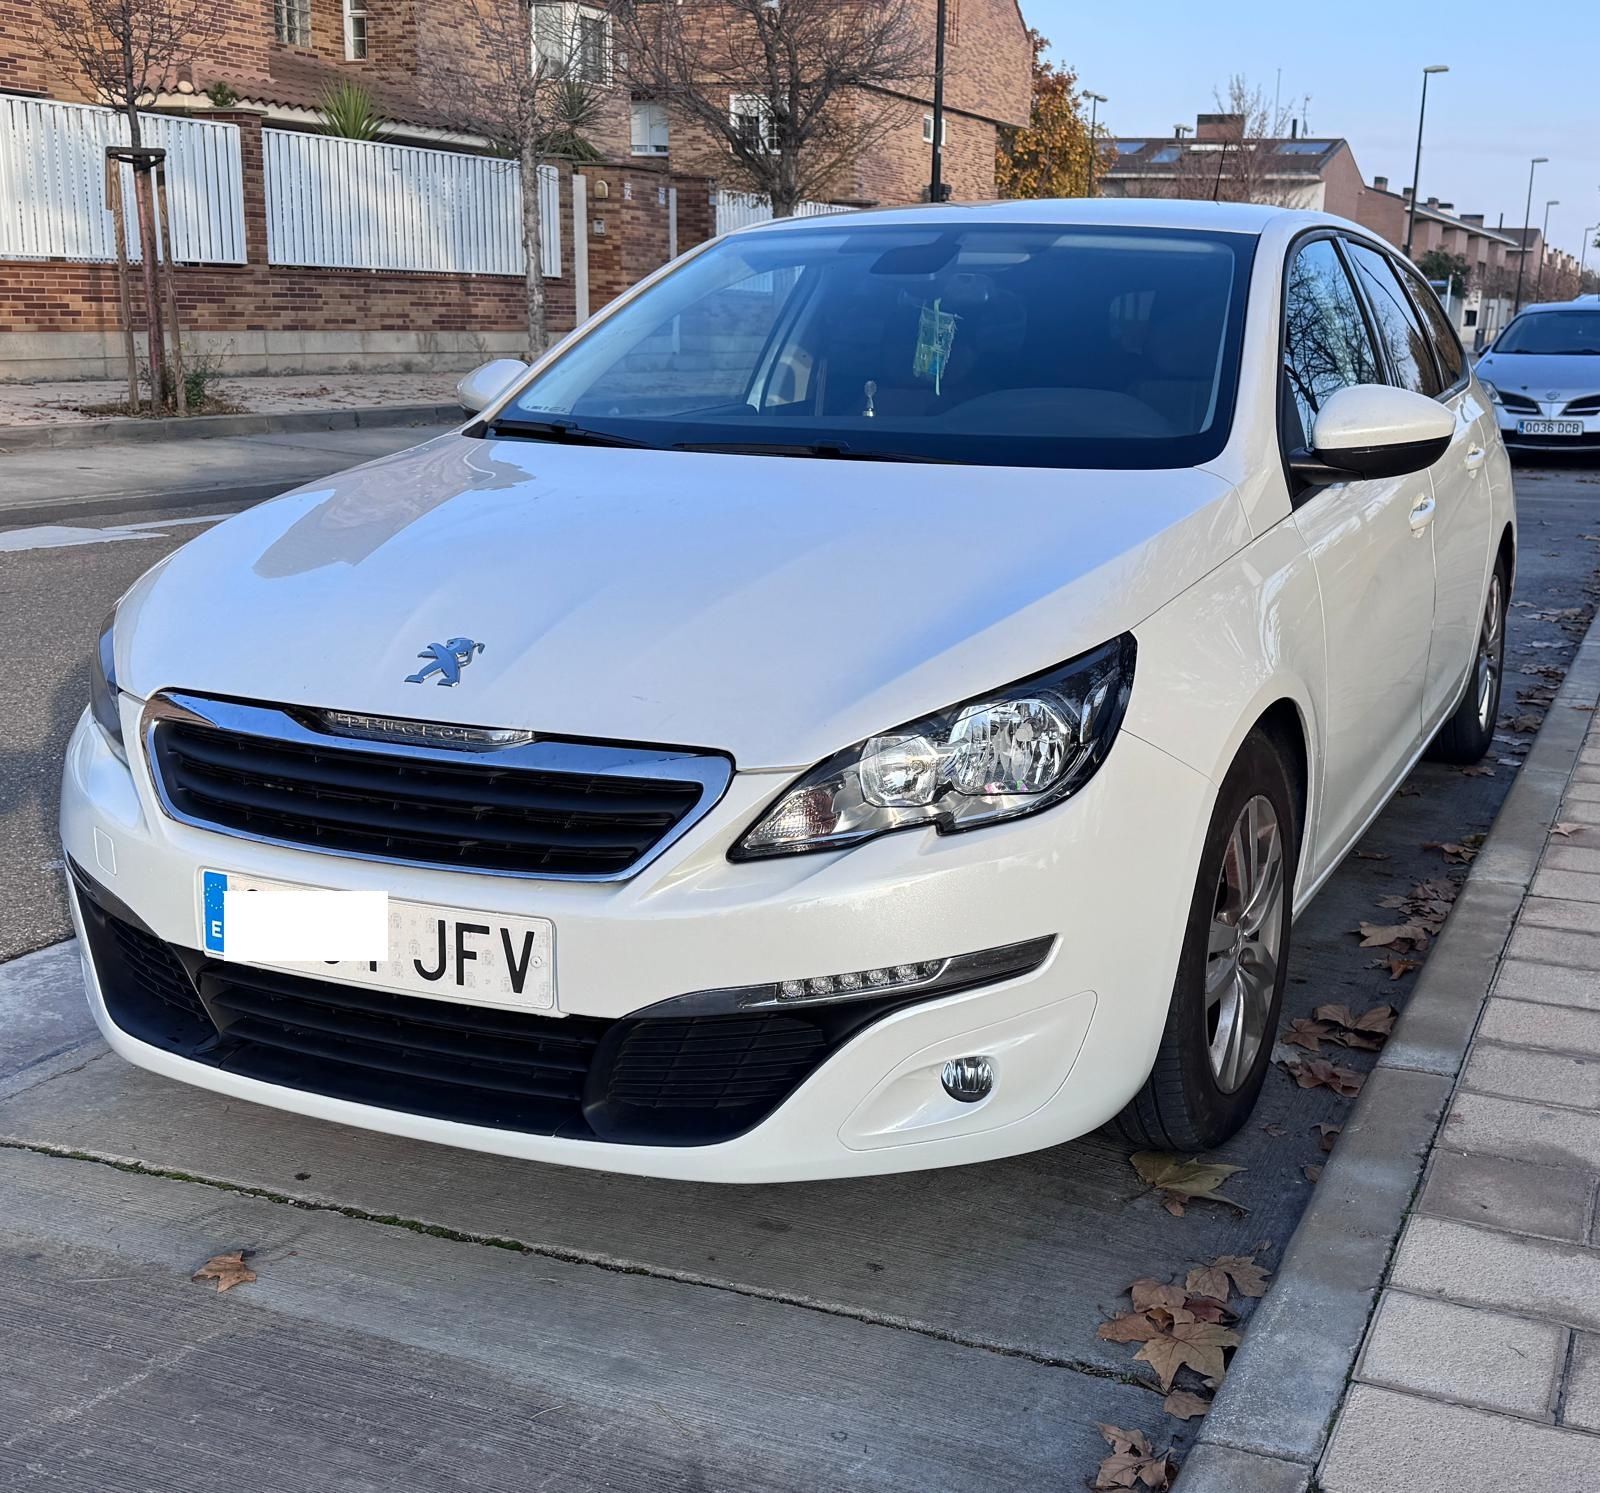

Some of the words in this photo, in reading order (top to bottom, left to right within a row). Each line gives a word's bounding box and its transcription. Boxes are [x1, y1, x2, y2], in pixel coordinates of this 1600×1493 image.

[1525, 422, 1554, 433] 0036
[1557, 423, 1580, 433] DCB
[211, 919, 223, 938] E
[413, 919, 536, 995] JFV
